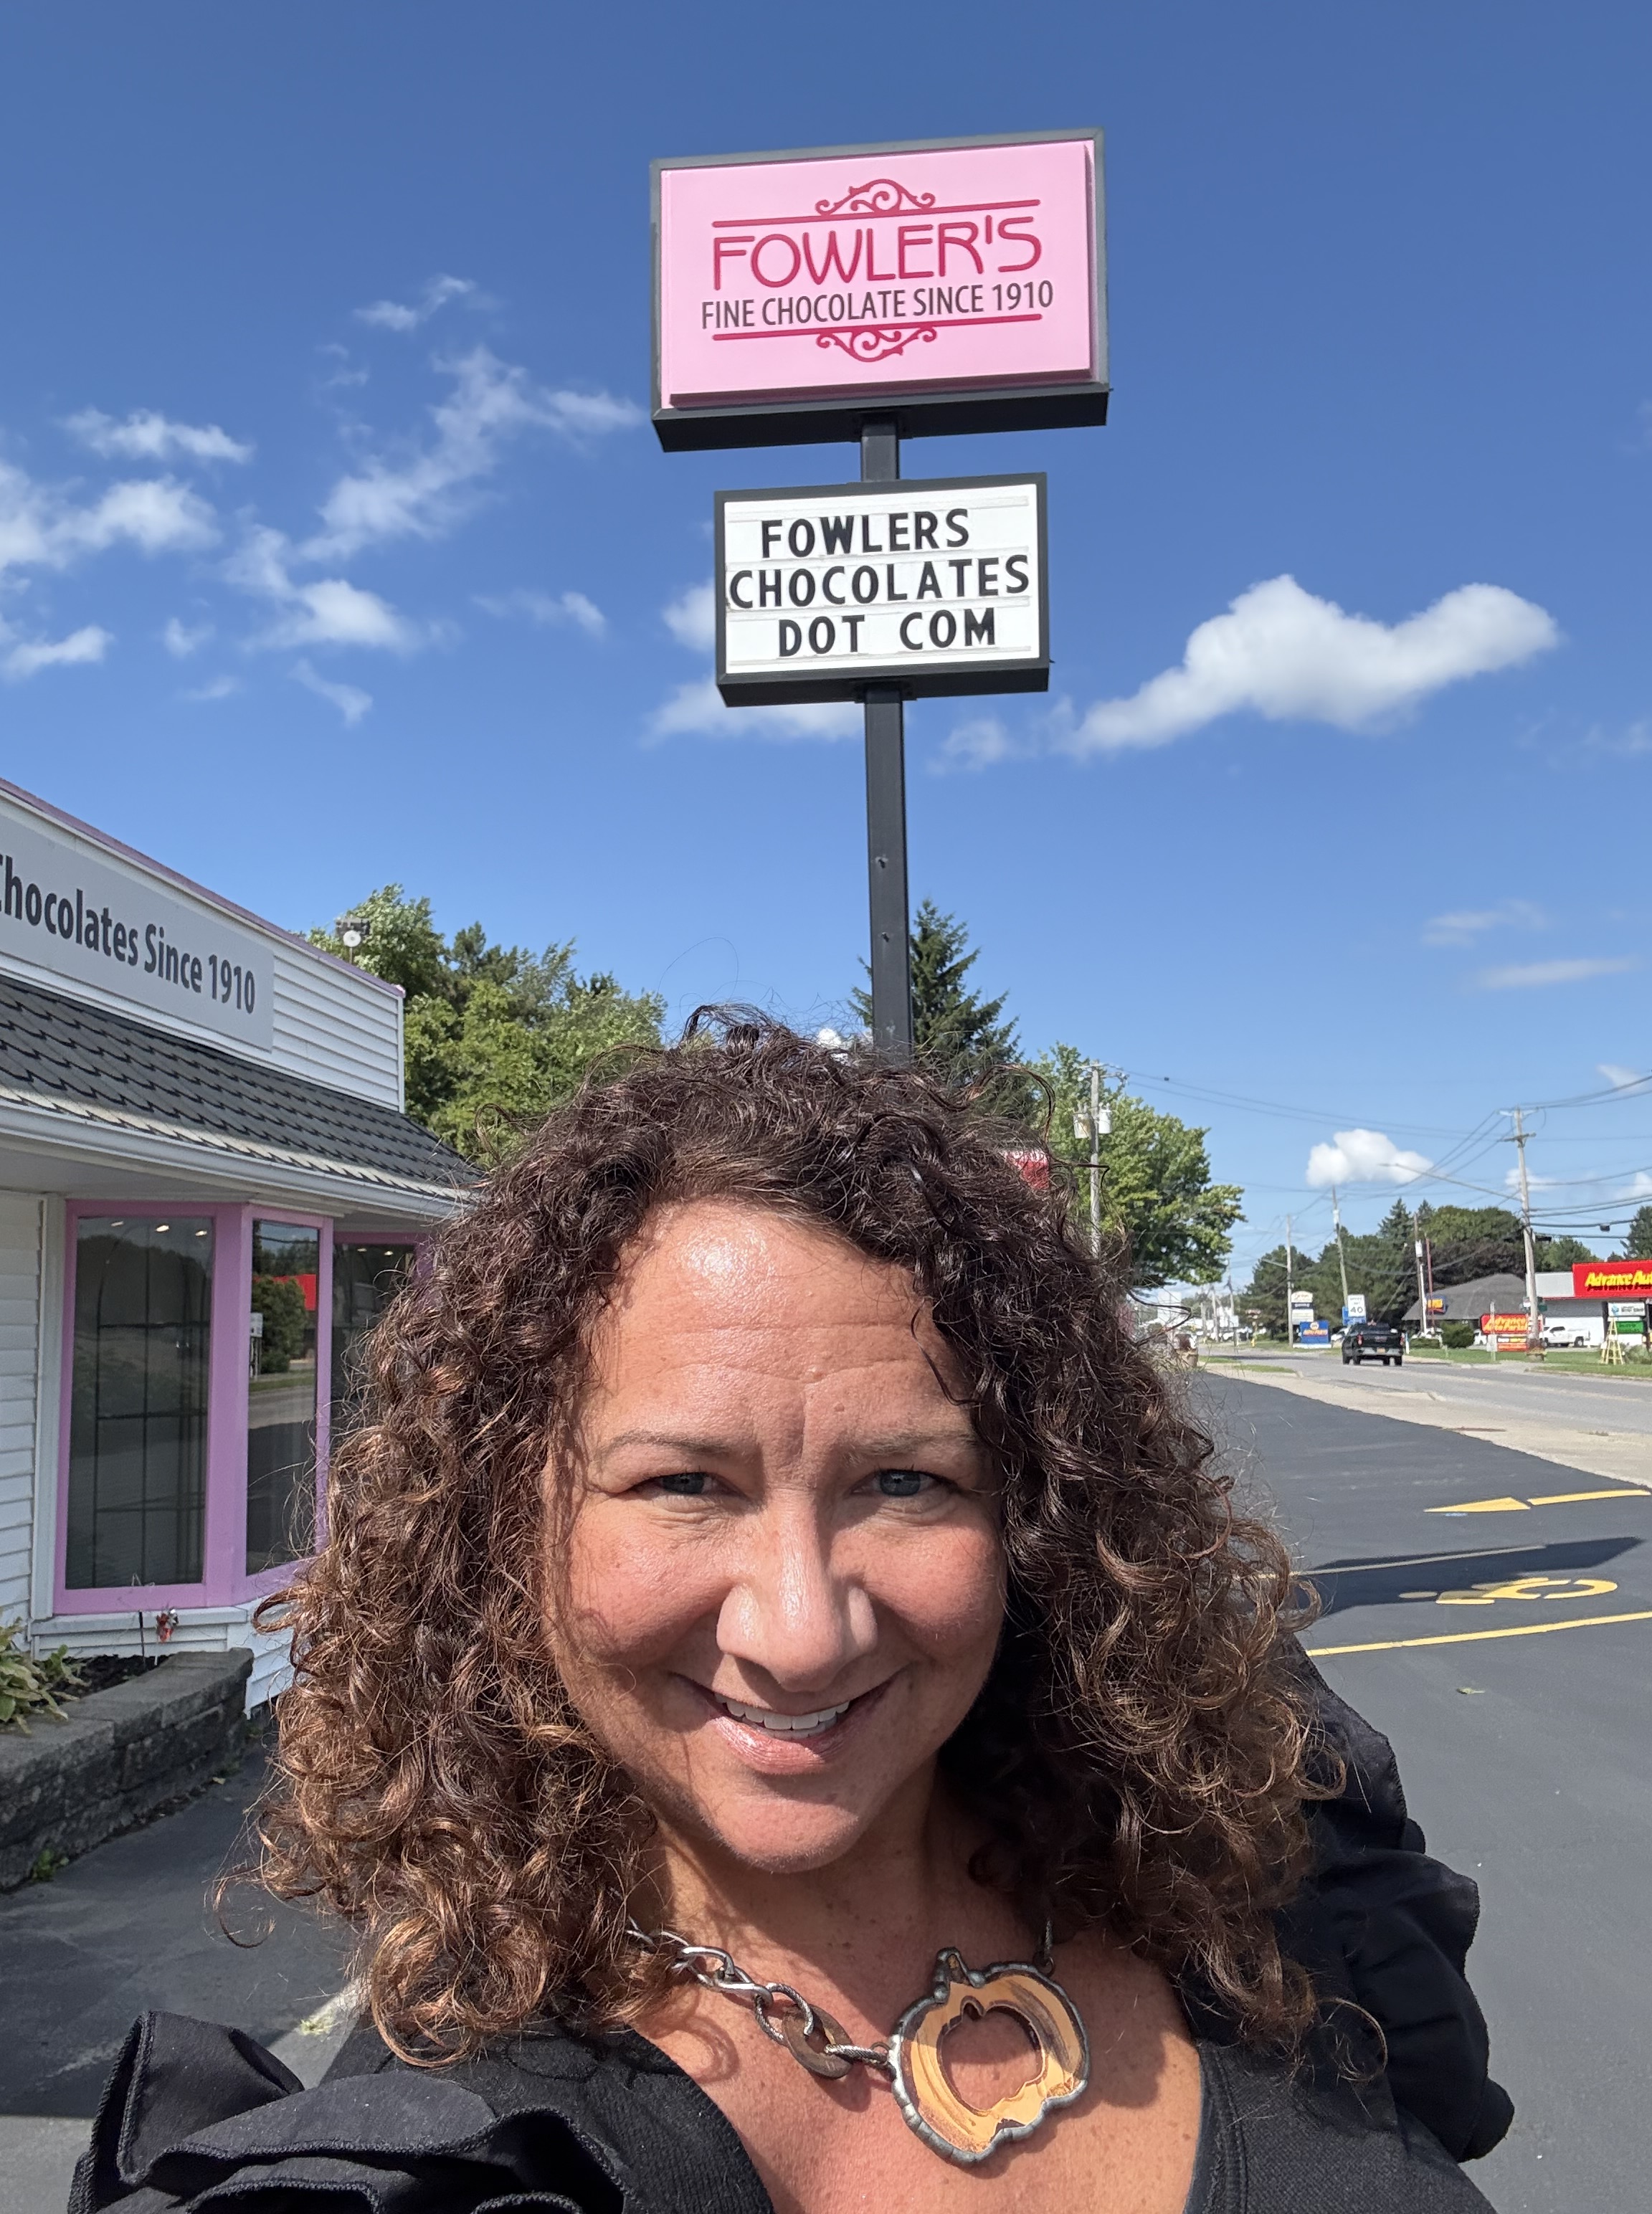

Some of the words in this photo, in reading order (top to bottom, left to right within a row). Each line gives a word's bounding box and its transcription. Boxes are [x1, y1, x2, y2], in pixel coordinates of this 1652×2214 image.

[714, 215, 1042, 290] FOWLER'S
[702, 298, 755, 329] FINE
[762, 289, 906, 326] CHOCOLATE
[913, 284, 984, 315] SINCE
[992, 280, 1053, 310] 1910
[761, 508, 969, 559] FOWLERS
[729, 554, 1029, 609] CHOCOLATES
[778, 614, 865, 657] DOT
[899, 607, 995, 650] COM
[0, 853, 138, 966] hocolates
[144, 923, 202, 994] Since
[208, 954, 256, 1014] 1910
[1585, 1271, 1633, 1287] Advance
